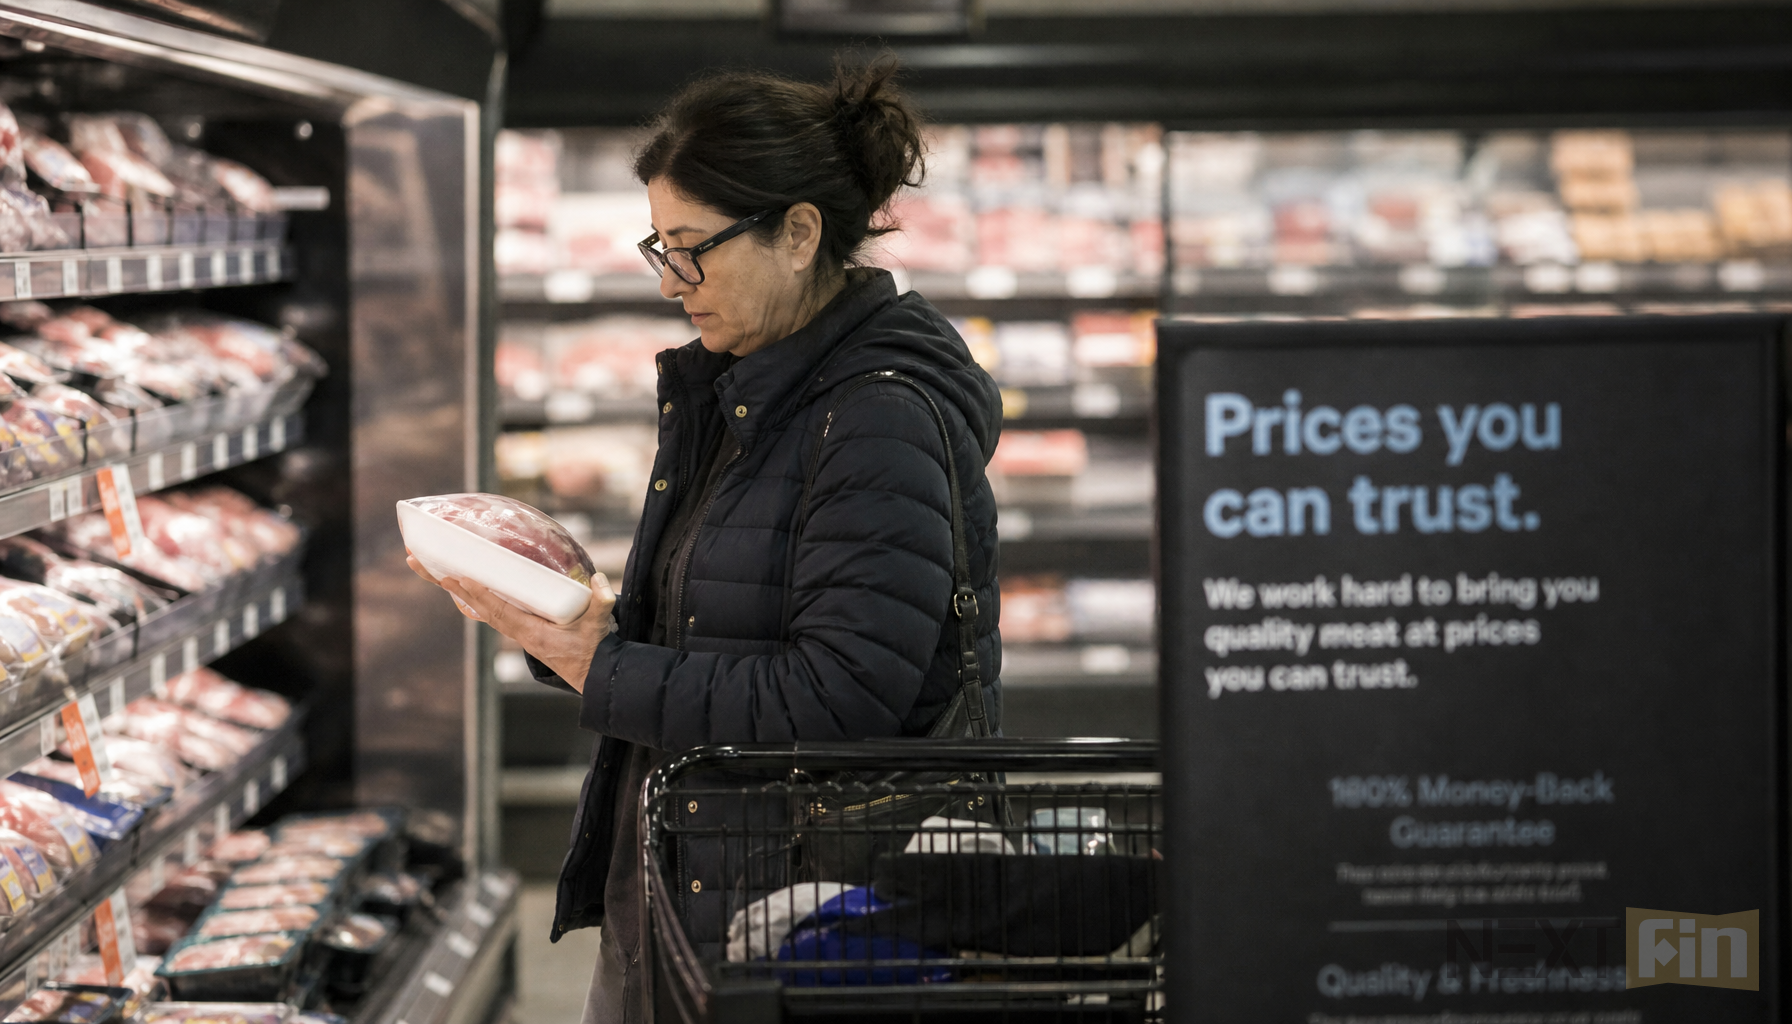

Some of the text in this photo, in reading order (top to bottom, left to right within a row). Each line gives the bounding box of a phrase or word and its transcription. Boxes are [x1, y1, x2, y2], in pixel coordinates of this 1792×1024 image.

[1205, 390, 1560, 465] Prices you
[1204, 475, 1539, 537] can trust.
[1204, 573, 1599, 608] We work hard to bring you
[1205, 613, 1540, 656] quality meat at prices
[1206, 660, 1418, 698] you can trust.
[1417, 773, 1613, 810] Money-Back
[1389, 815, 1554, 848] Guarantee
[1317, 964, 1431, 999] Quality
[1436, 962, 1464, 996] &
